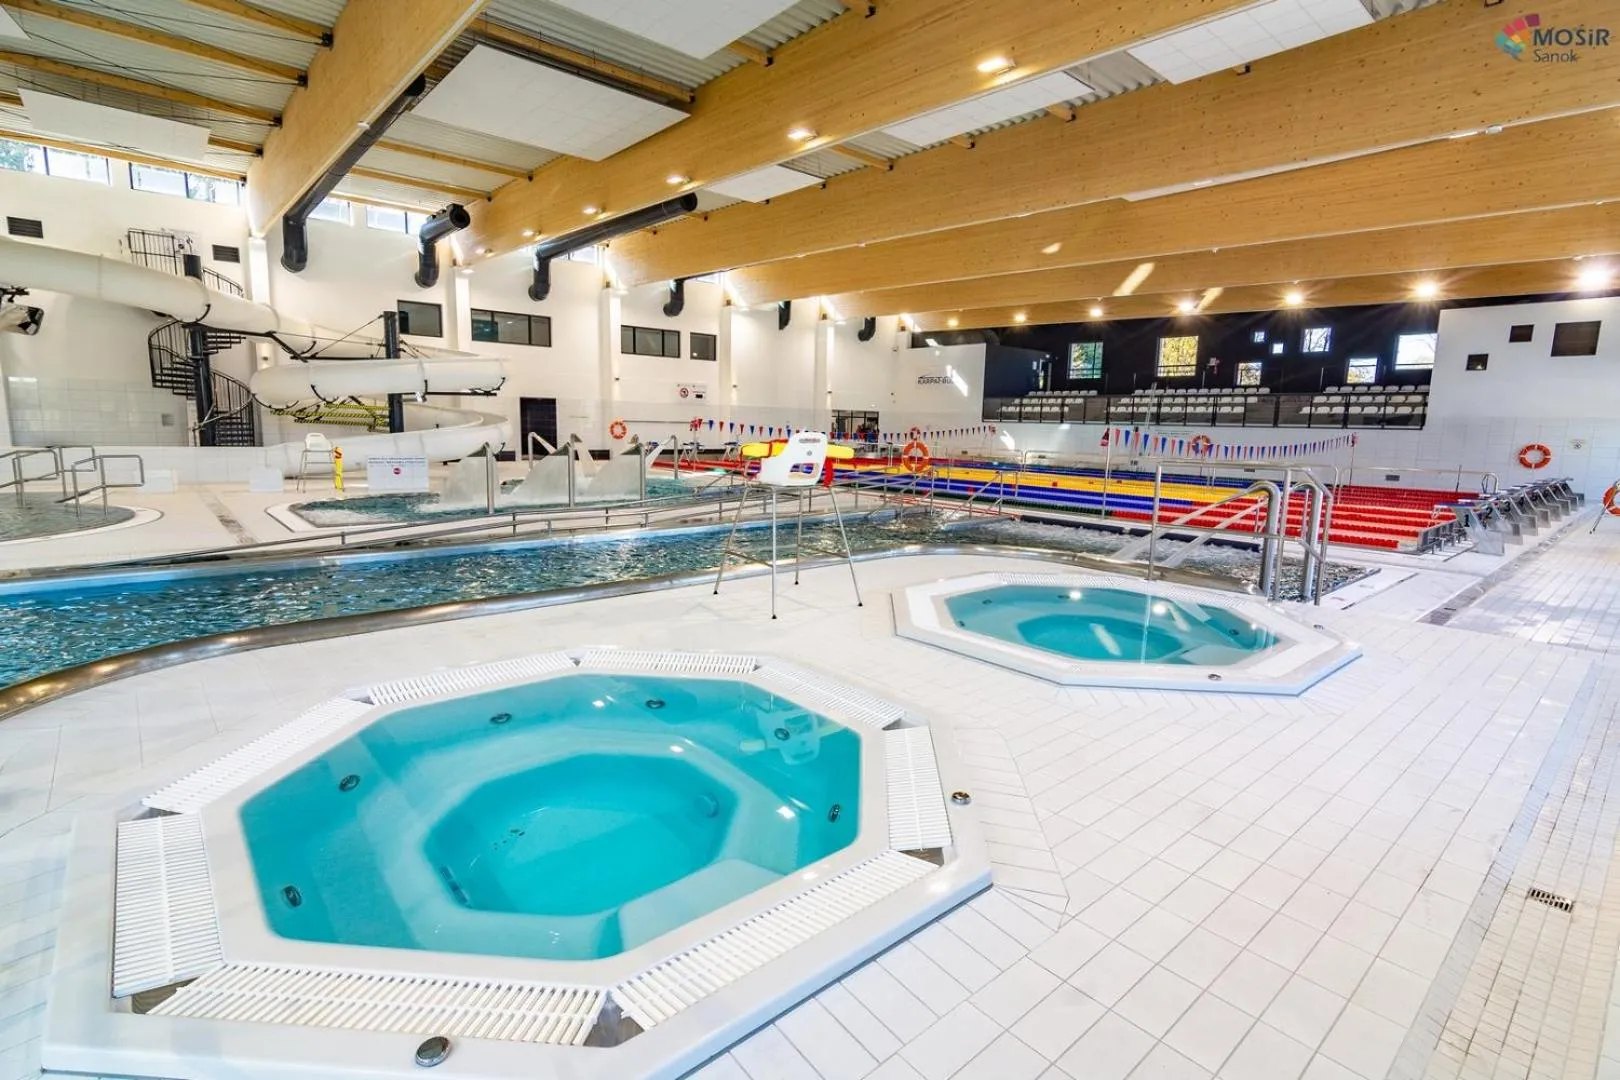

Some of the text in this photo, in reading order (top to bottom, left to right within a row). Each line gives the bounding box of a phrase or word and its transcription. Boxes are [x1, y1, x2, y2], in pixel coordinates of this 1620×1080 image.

[1485, 506, 1493, 519] 2
[1503, 501, 1511, 512] 3
[1464, 514, 1470, 527] 1
